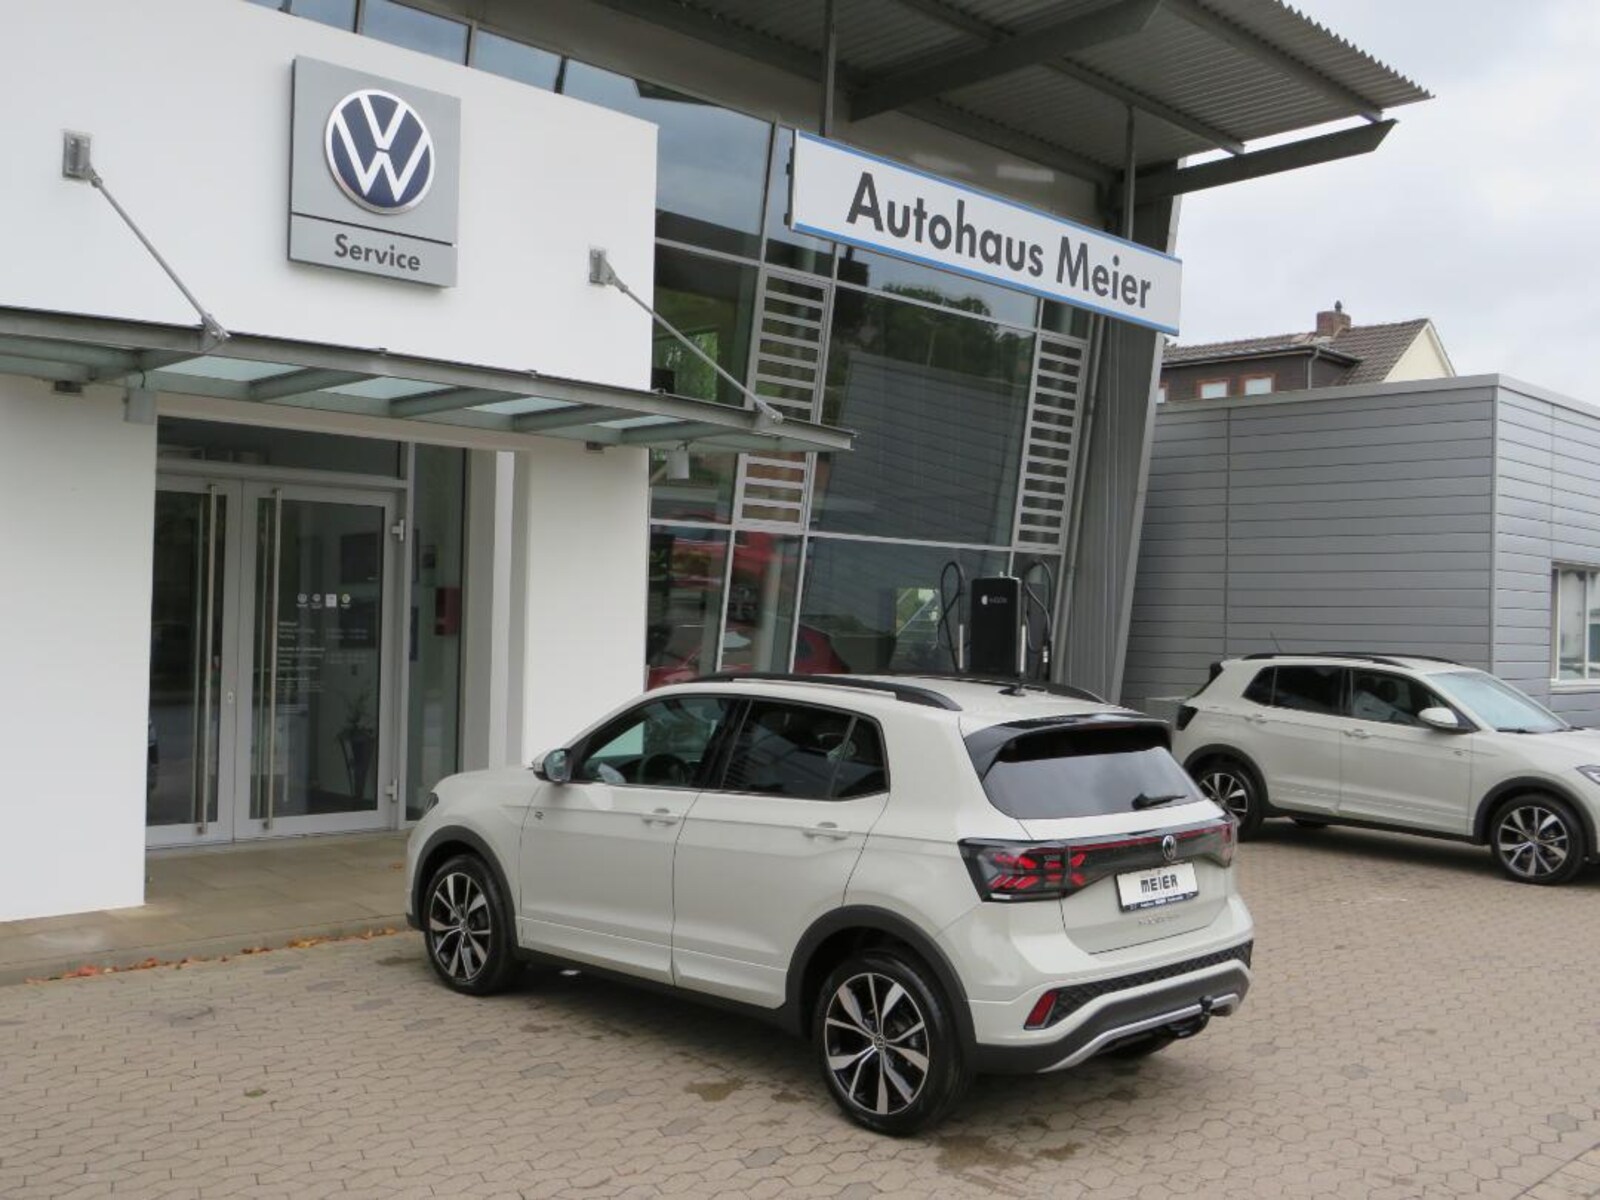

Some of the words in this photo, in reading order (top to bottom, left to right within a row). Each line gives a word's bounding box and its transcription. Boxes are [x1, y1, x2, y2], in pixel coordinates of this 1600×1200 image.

[334, 233, 421, 271] Service
[846, 171, 1044, 277] Autohaus
[1056, 236, 1152, 308] Meier
[1140, 875, 1179, 893] MEIER
